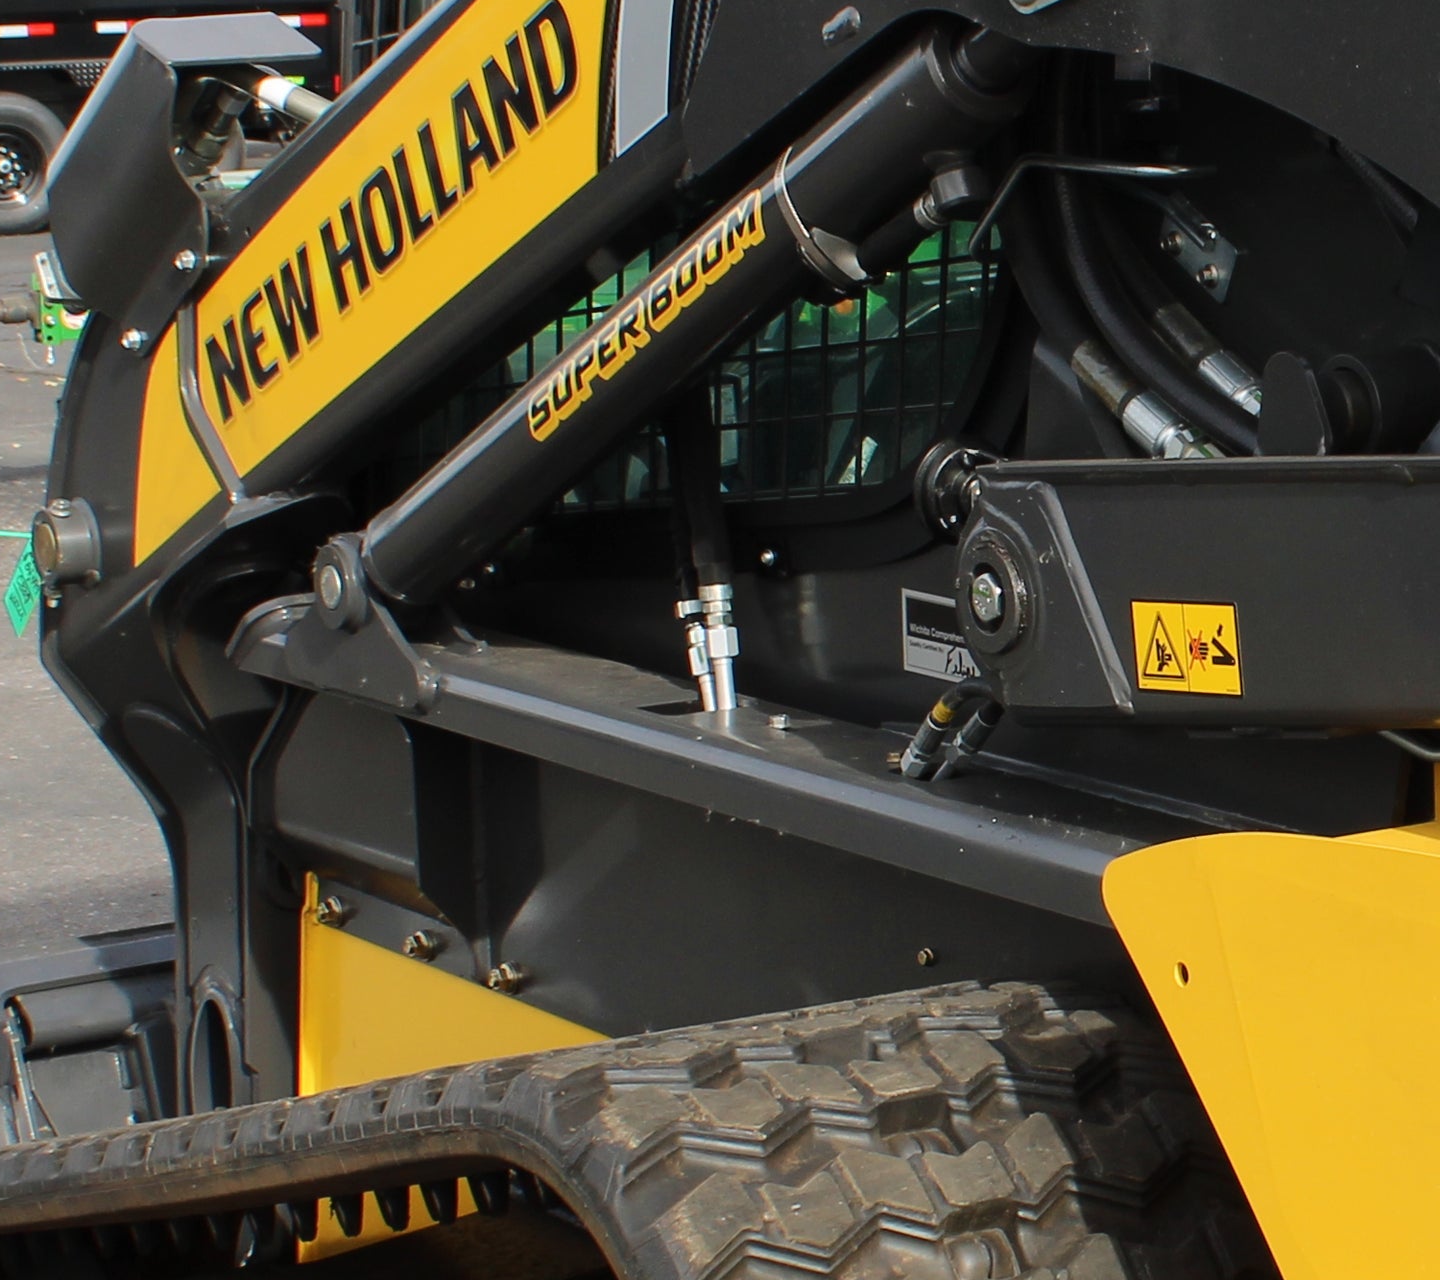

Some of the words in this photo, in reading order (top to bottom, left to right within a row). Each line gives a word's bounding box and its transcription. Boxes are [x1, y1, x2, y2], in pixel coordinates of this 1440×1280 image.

[204, 240, 322, 424] NEW
[529, 298, 650, 440] SUPER
[649, 190, 765, 330] BOOM
